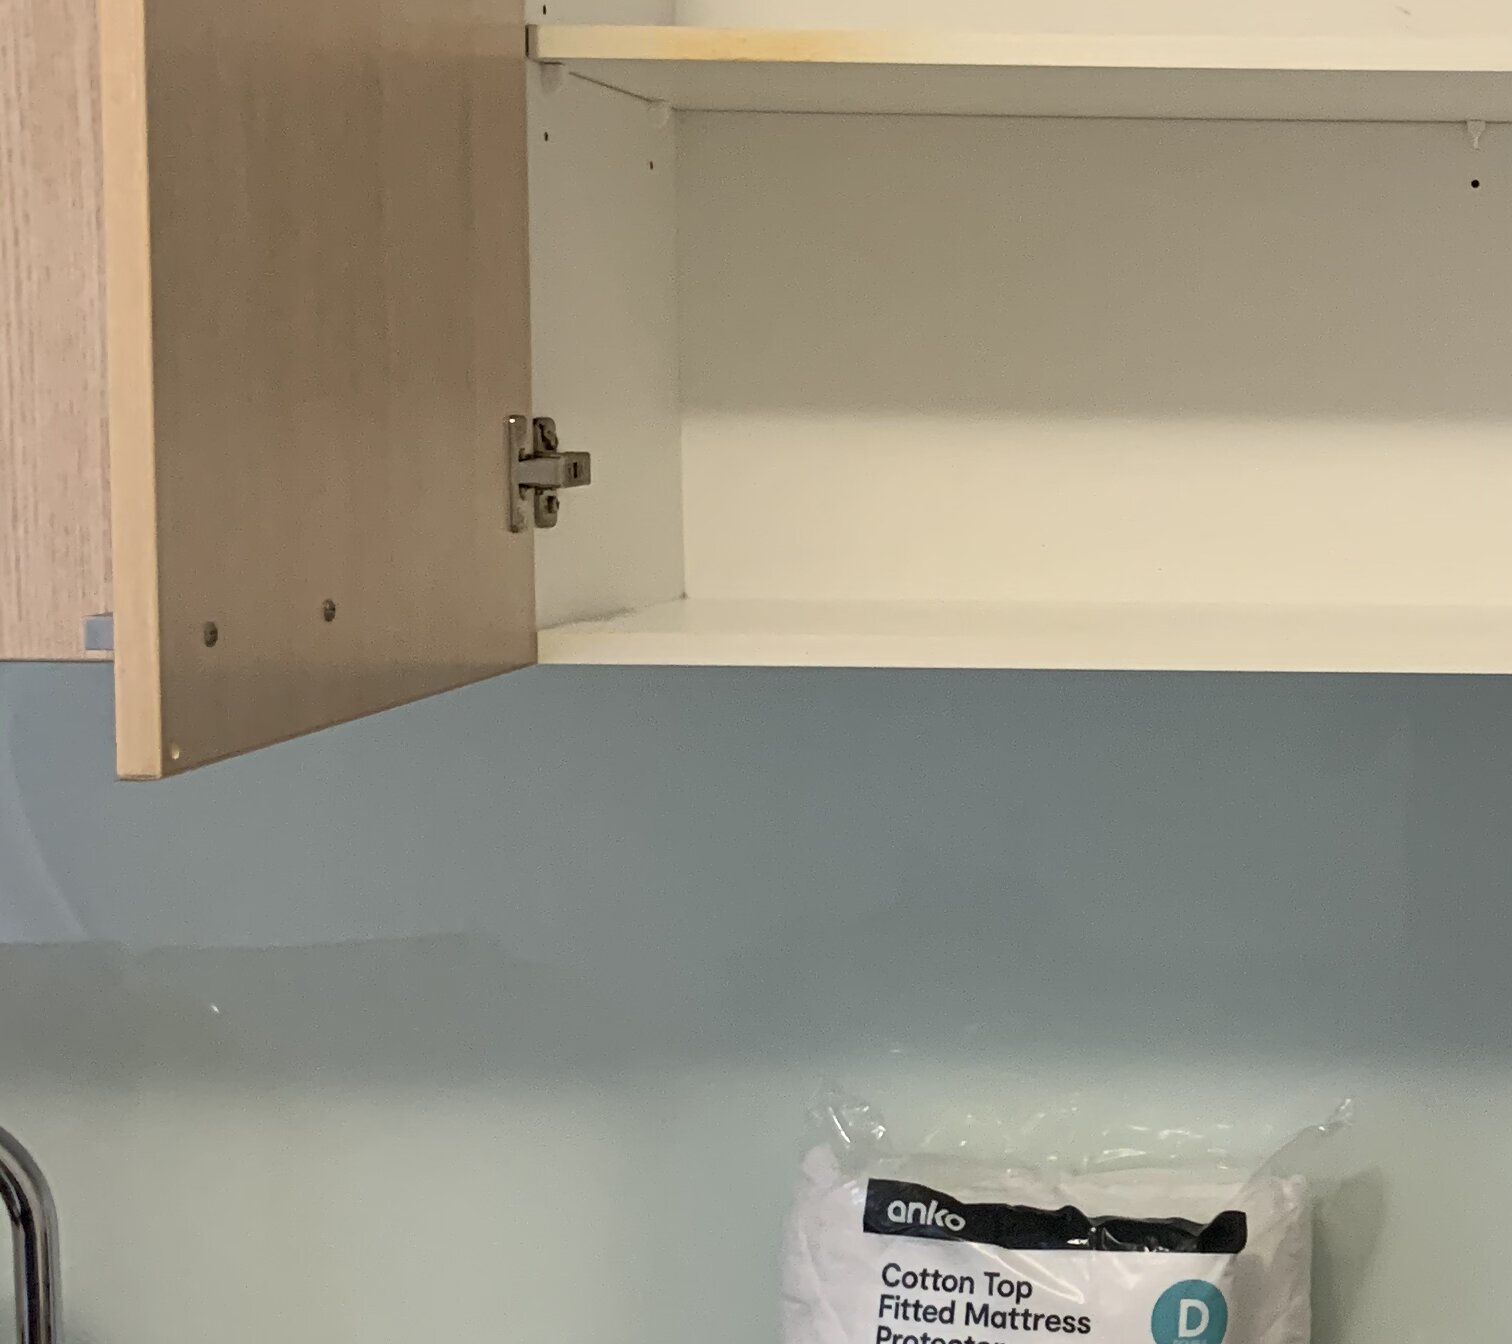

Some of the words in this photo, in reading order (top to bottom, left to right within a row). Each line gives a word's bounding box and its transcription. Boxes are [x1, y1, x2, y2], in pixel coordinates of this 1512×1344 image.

[887, 1199, 966, 1232] anko
[881, 1263, 975, 1295] Cotton
[984, 1271, 1033, 1304] Top
[878, 1294, 956, 1325] Fitted
[964, 1302, 1091, 1334] Mattress
[1178, 1298, 1209, 1338] D
